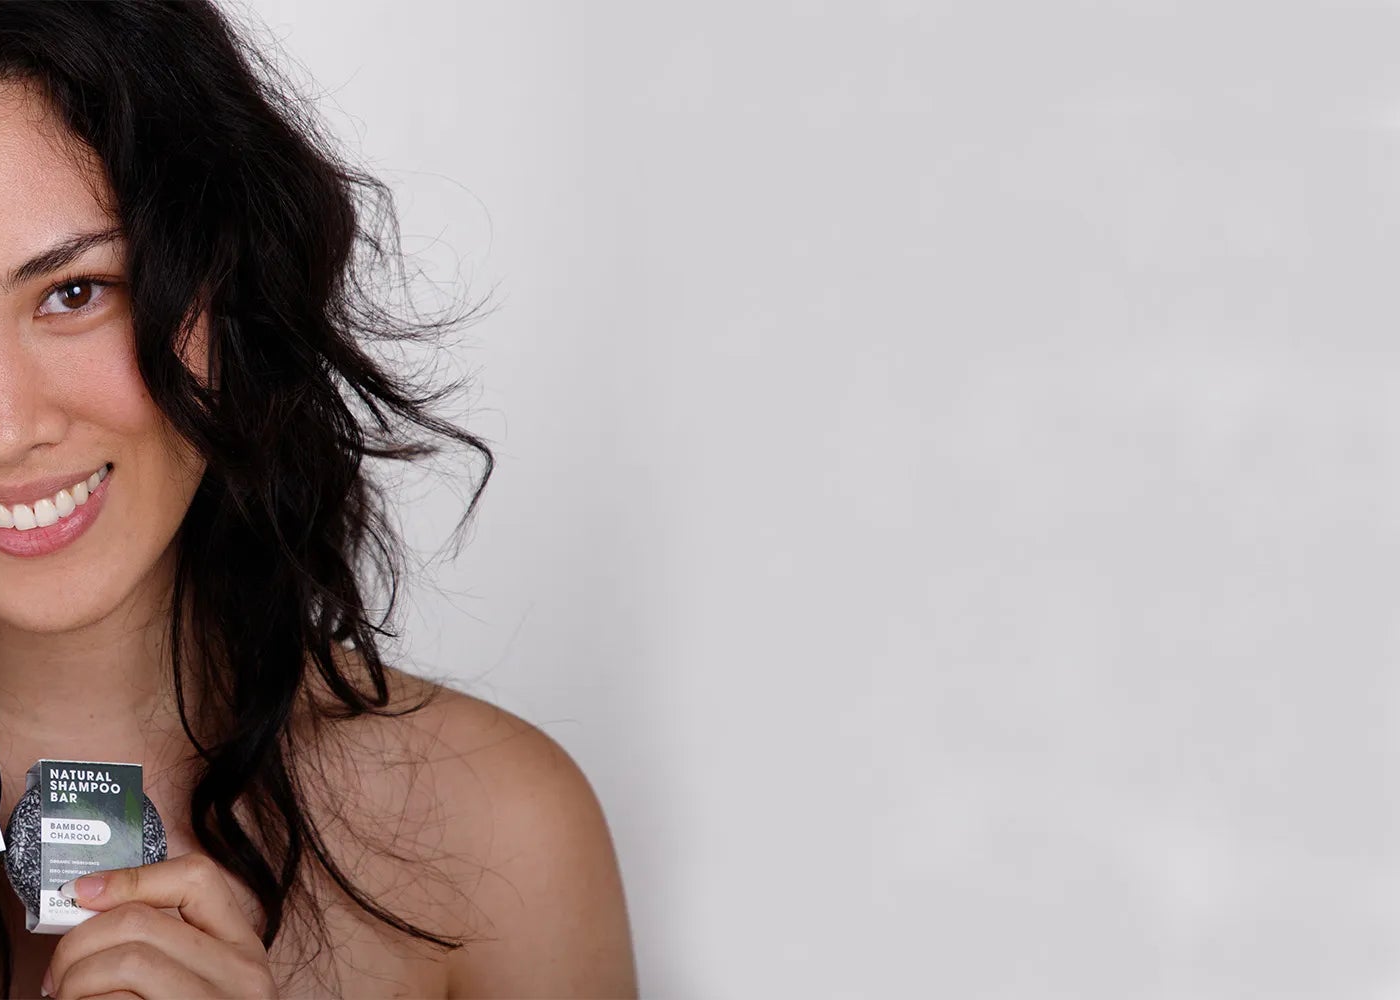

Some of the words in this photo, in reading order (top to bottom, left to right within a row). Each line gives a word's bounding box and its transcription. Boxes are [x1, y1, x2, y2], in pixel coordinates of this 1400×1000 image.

[50, 769, 112, 781] NATURAL
[50, 780, 121, 794] SHAMPOO
[50, 792, 77, 803] BAR
[50, 822, 90, 831] BAMBOO
[50, 832, 101, 841] CHARCOAL
[49, 897, 78, 908] Seek
